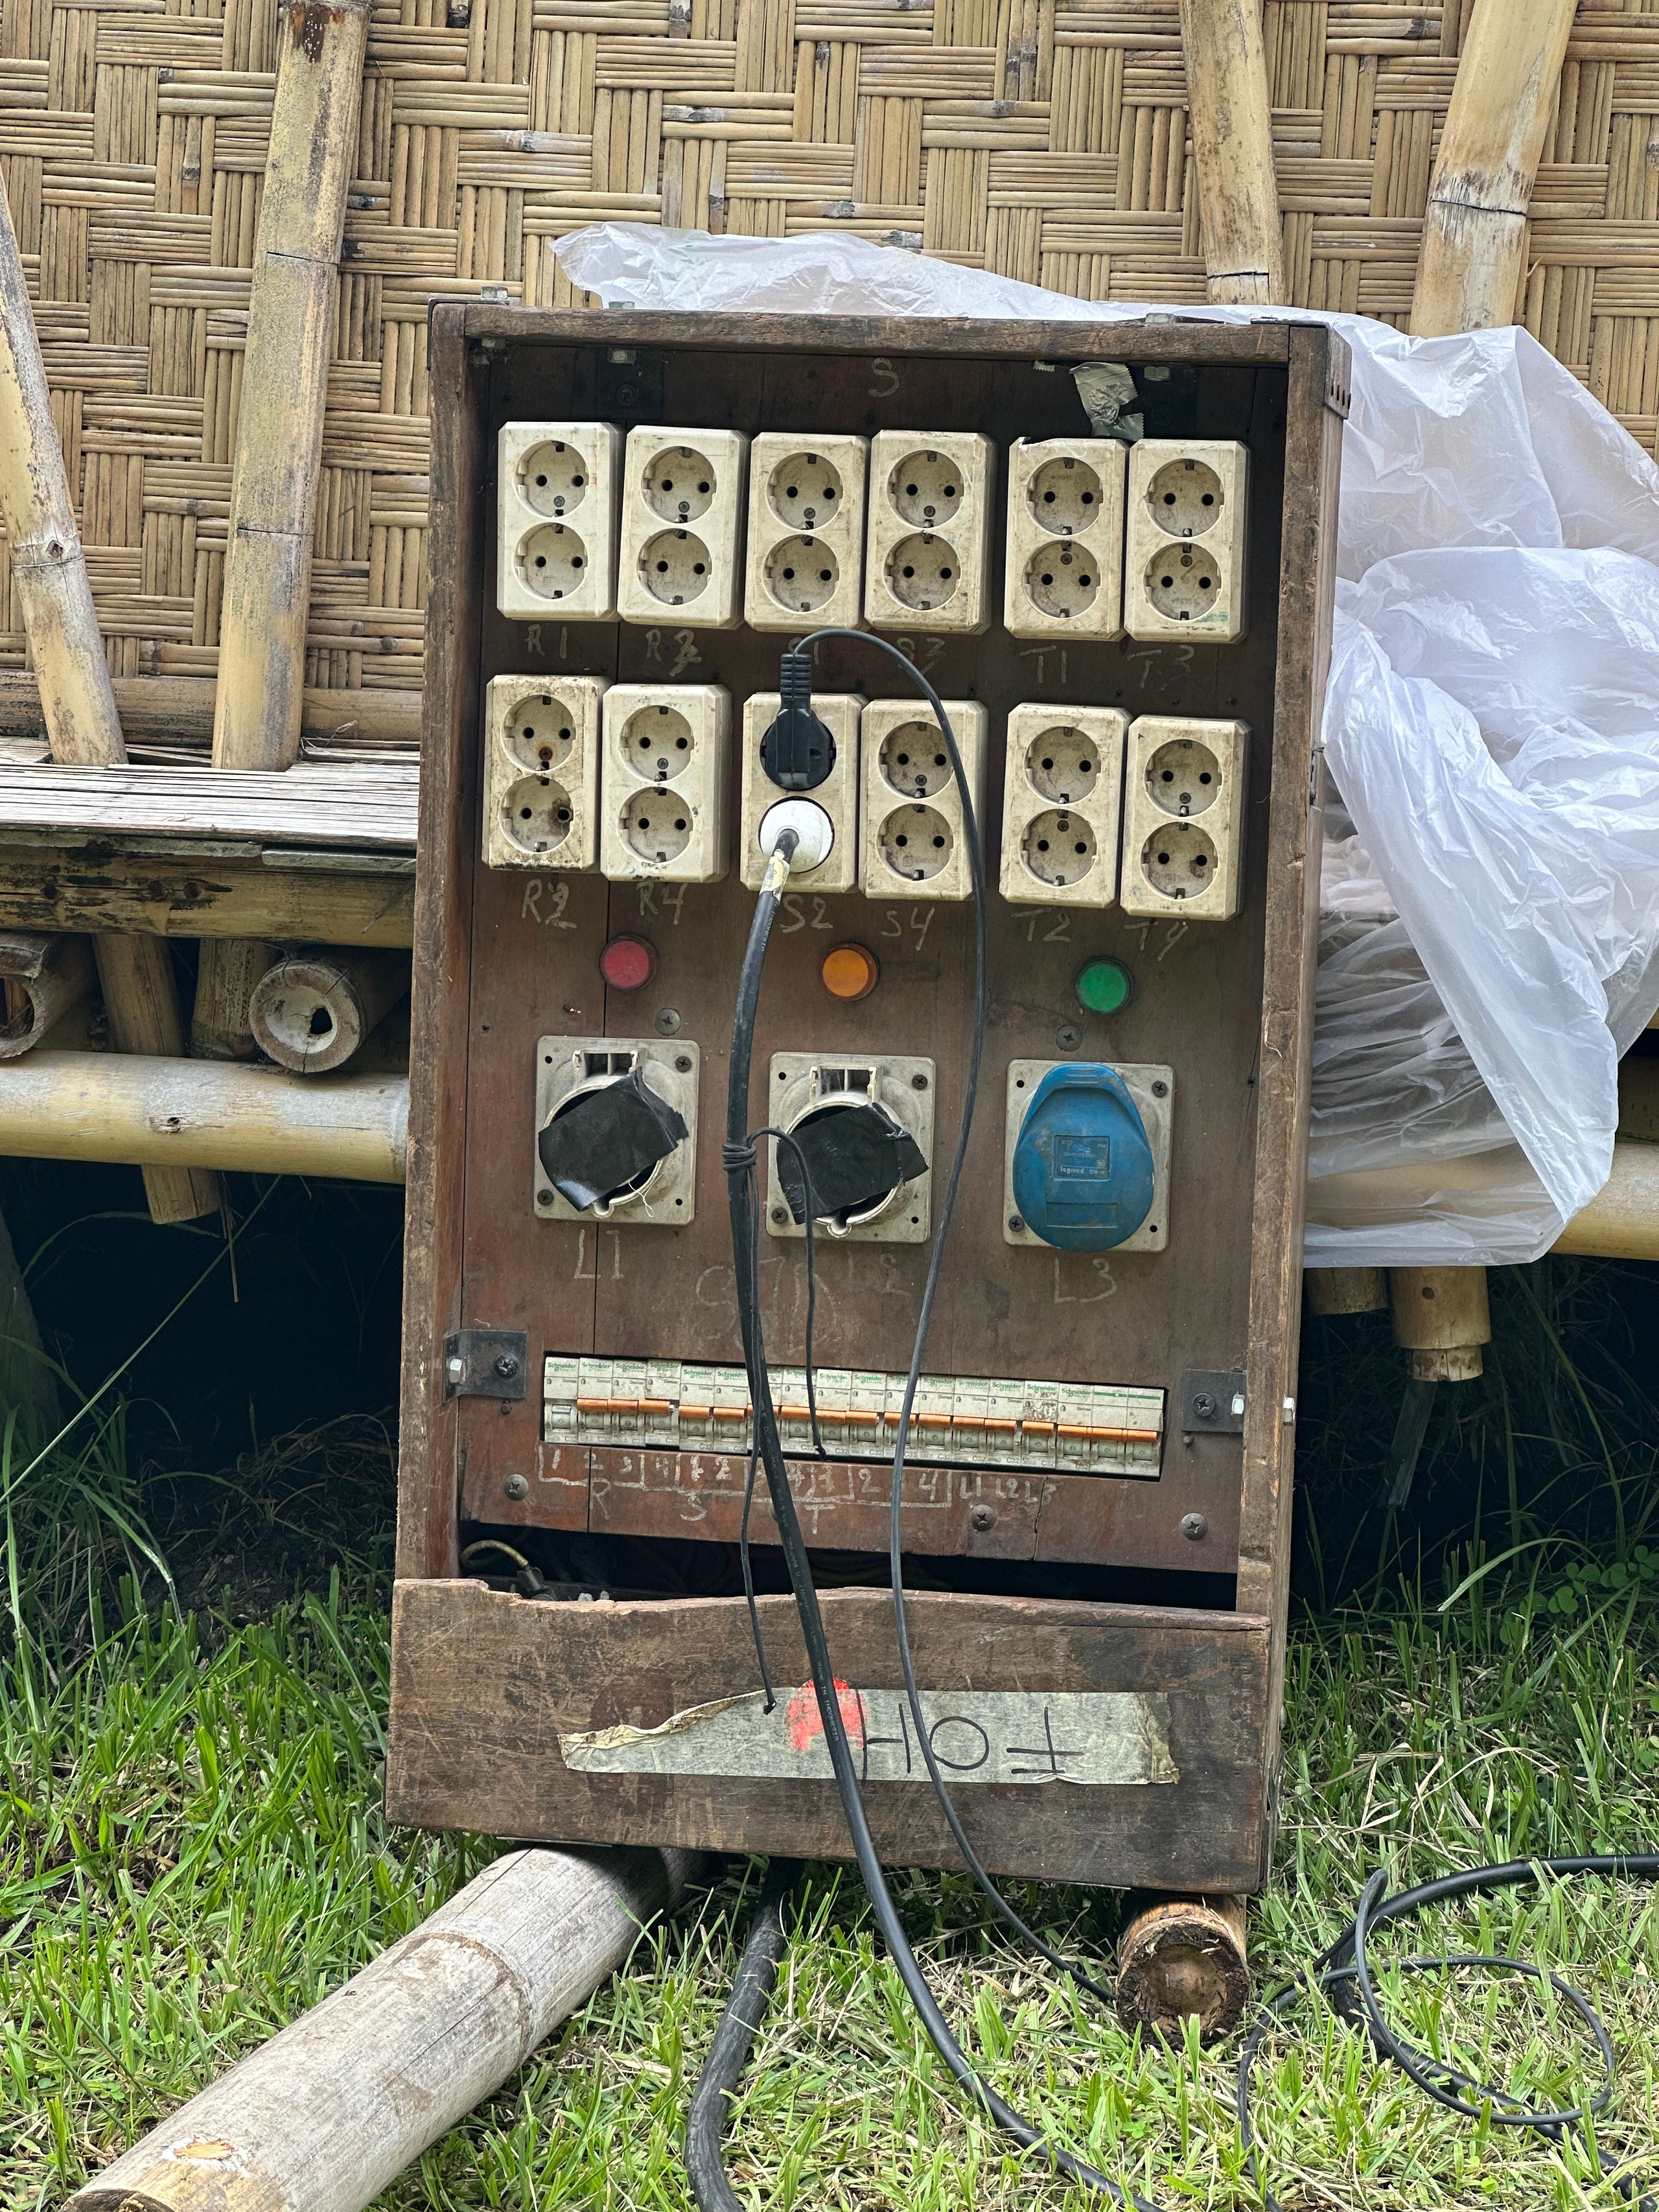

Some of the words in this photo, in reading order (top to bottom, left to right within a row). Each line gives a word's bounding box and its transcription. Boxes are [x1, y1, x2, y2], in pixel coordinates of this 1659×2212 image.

[868, 357, 899, 397] S
[636, 881, 688, 925] R4
[780, 893, 833, 933] S2
[880, 907, 934, 950] S4
[1011, 909, 1071, 942] T2
[1054, 1257, 1117, 1304] L3
[548, 1362, 576, 1372] Schneider
[583, 1362, 610, 1372] Schneider
[616, 1362, 644, 1373] Schneider
[650, 1362, 679, 1372] Schneider
[683, 1368, 713, 1380] Schneider
[854, 1373, 883, 1384] Schneider
[923, 1377, 953, 1387] Schneider
[992, 1381, 1023, 1392] Schneider
[1027, 1384, 1057, 1393] Schneider
[1062, 1387, 1091, 1397] Schneider
[858, 1468, 881, 1493] 2
[589, 1478, 612, 1520] R
[804, 1504, 836, 1535] T
[822, 1685, 828, 1695] IN
[824, 1698, 839, 1741] INDONESIA
